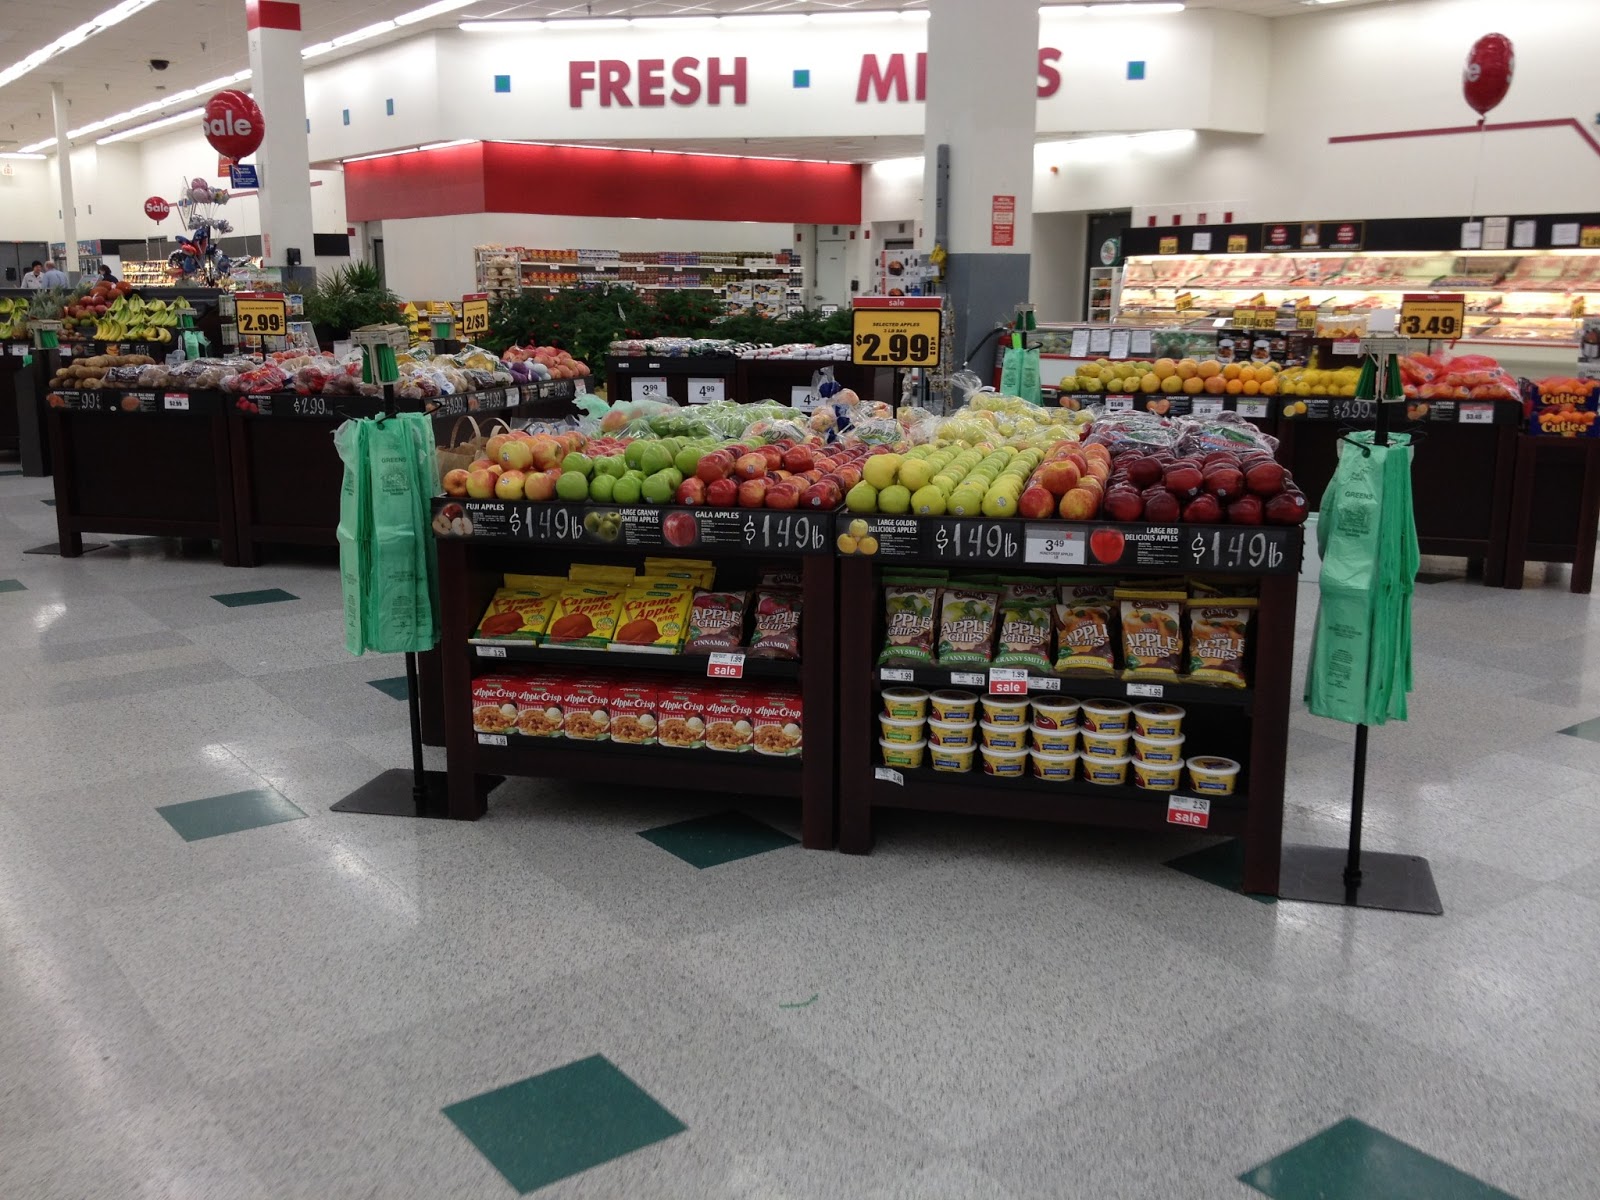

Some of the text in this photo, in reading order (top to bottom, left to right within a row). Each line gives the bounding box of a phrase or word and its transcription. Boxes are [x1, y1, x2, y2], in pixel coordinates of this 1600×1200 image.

[569, 56, 747, 108] FRESH
[146, 202, 169, 213] Sale
[889, 299, 905, 307] sale
[239, 313, 280, 331] $2.99
[466, 314, 486, 331] 2/$3
[1402, 315, 1455, 335] $3.49
[856, 333, 929, 362] $2.99
[1541, 393, 1586, 405] Cuties
[1541, 421, 1587, 433] Cuties
[1344, 491, 1373, 500] GREENS
[466, 503, 479, 511] FUJI
[621, 515, 639, 523] SMITH
[896, 519, 917, 527] GOLDEN
[495, 593, 552, 606] Caramel
[561, 592, 620, 606] Caramel
[625, 593, 684, 611] Caramel
[502, 600, 544, 613] Apple
[571, 601, 612, 614] Apple
[634, 605, 676, 620] Apple
[592, 609, 614, 618] wrap
[656, 613, 679, 623] wrap
[692, 608, 741, 624] APPLE
[697, 620, 731, 628] CHIPS
[948, 633, 984, 642] CHIPS
[1004, 634, 1041, 644] CHIPS
[1126, 633, 1179, 651] APPLE
[754, 641, 790, 650] CINNAMON
[1132, 646, 1170, 658] CHIPS
[1199, 649, 1238, 660] CHIPS
[996, 655, 1046, 666] GRANNY SMITH
[714, 666, 736, 675] sale
[900, 672, 912, 680] 1.99
[1012, 671, 1025, 679] 1.99
[971, 676, 983, 685] 1.99
[473, 687, 517, 700] Apple Crisp
[996, 683, 1021, 692] sale
[518, 691, 562, 703] Apple Crisp
[564, 694, 609, 706] Apple Crisp
[611, 697, 656, 709] Apple Crisp
[659, 700, 704, 712] Apple Crisp
[706, 703, 752, 716] Apple Crisp
[754, 706, 801, 719] Apple Crisp
[1193, 800, 1208, 810] 2.50
[1175, 811, 1201, 824] sale
